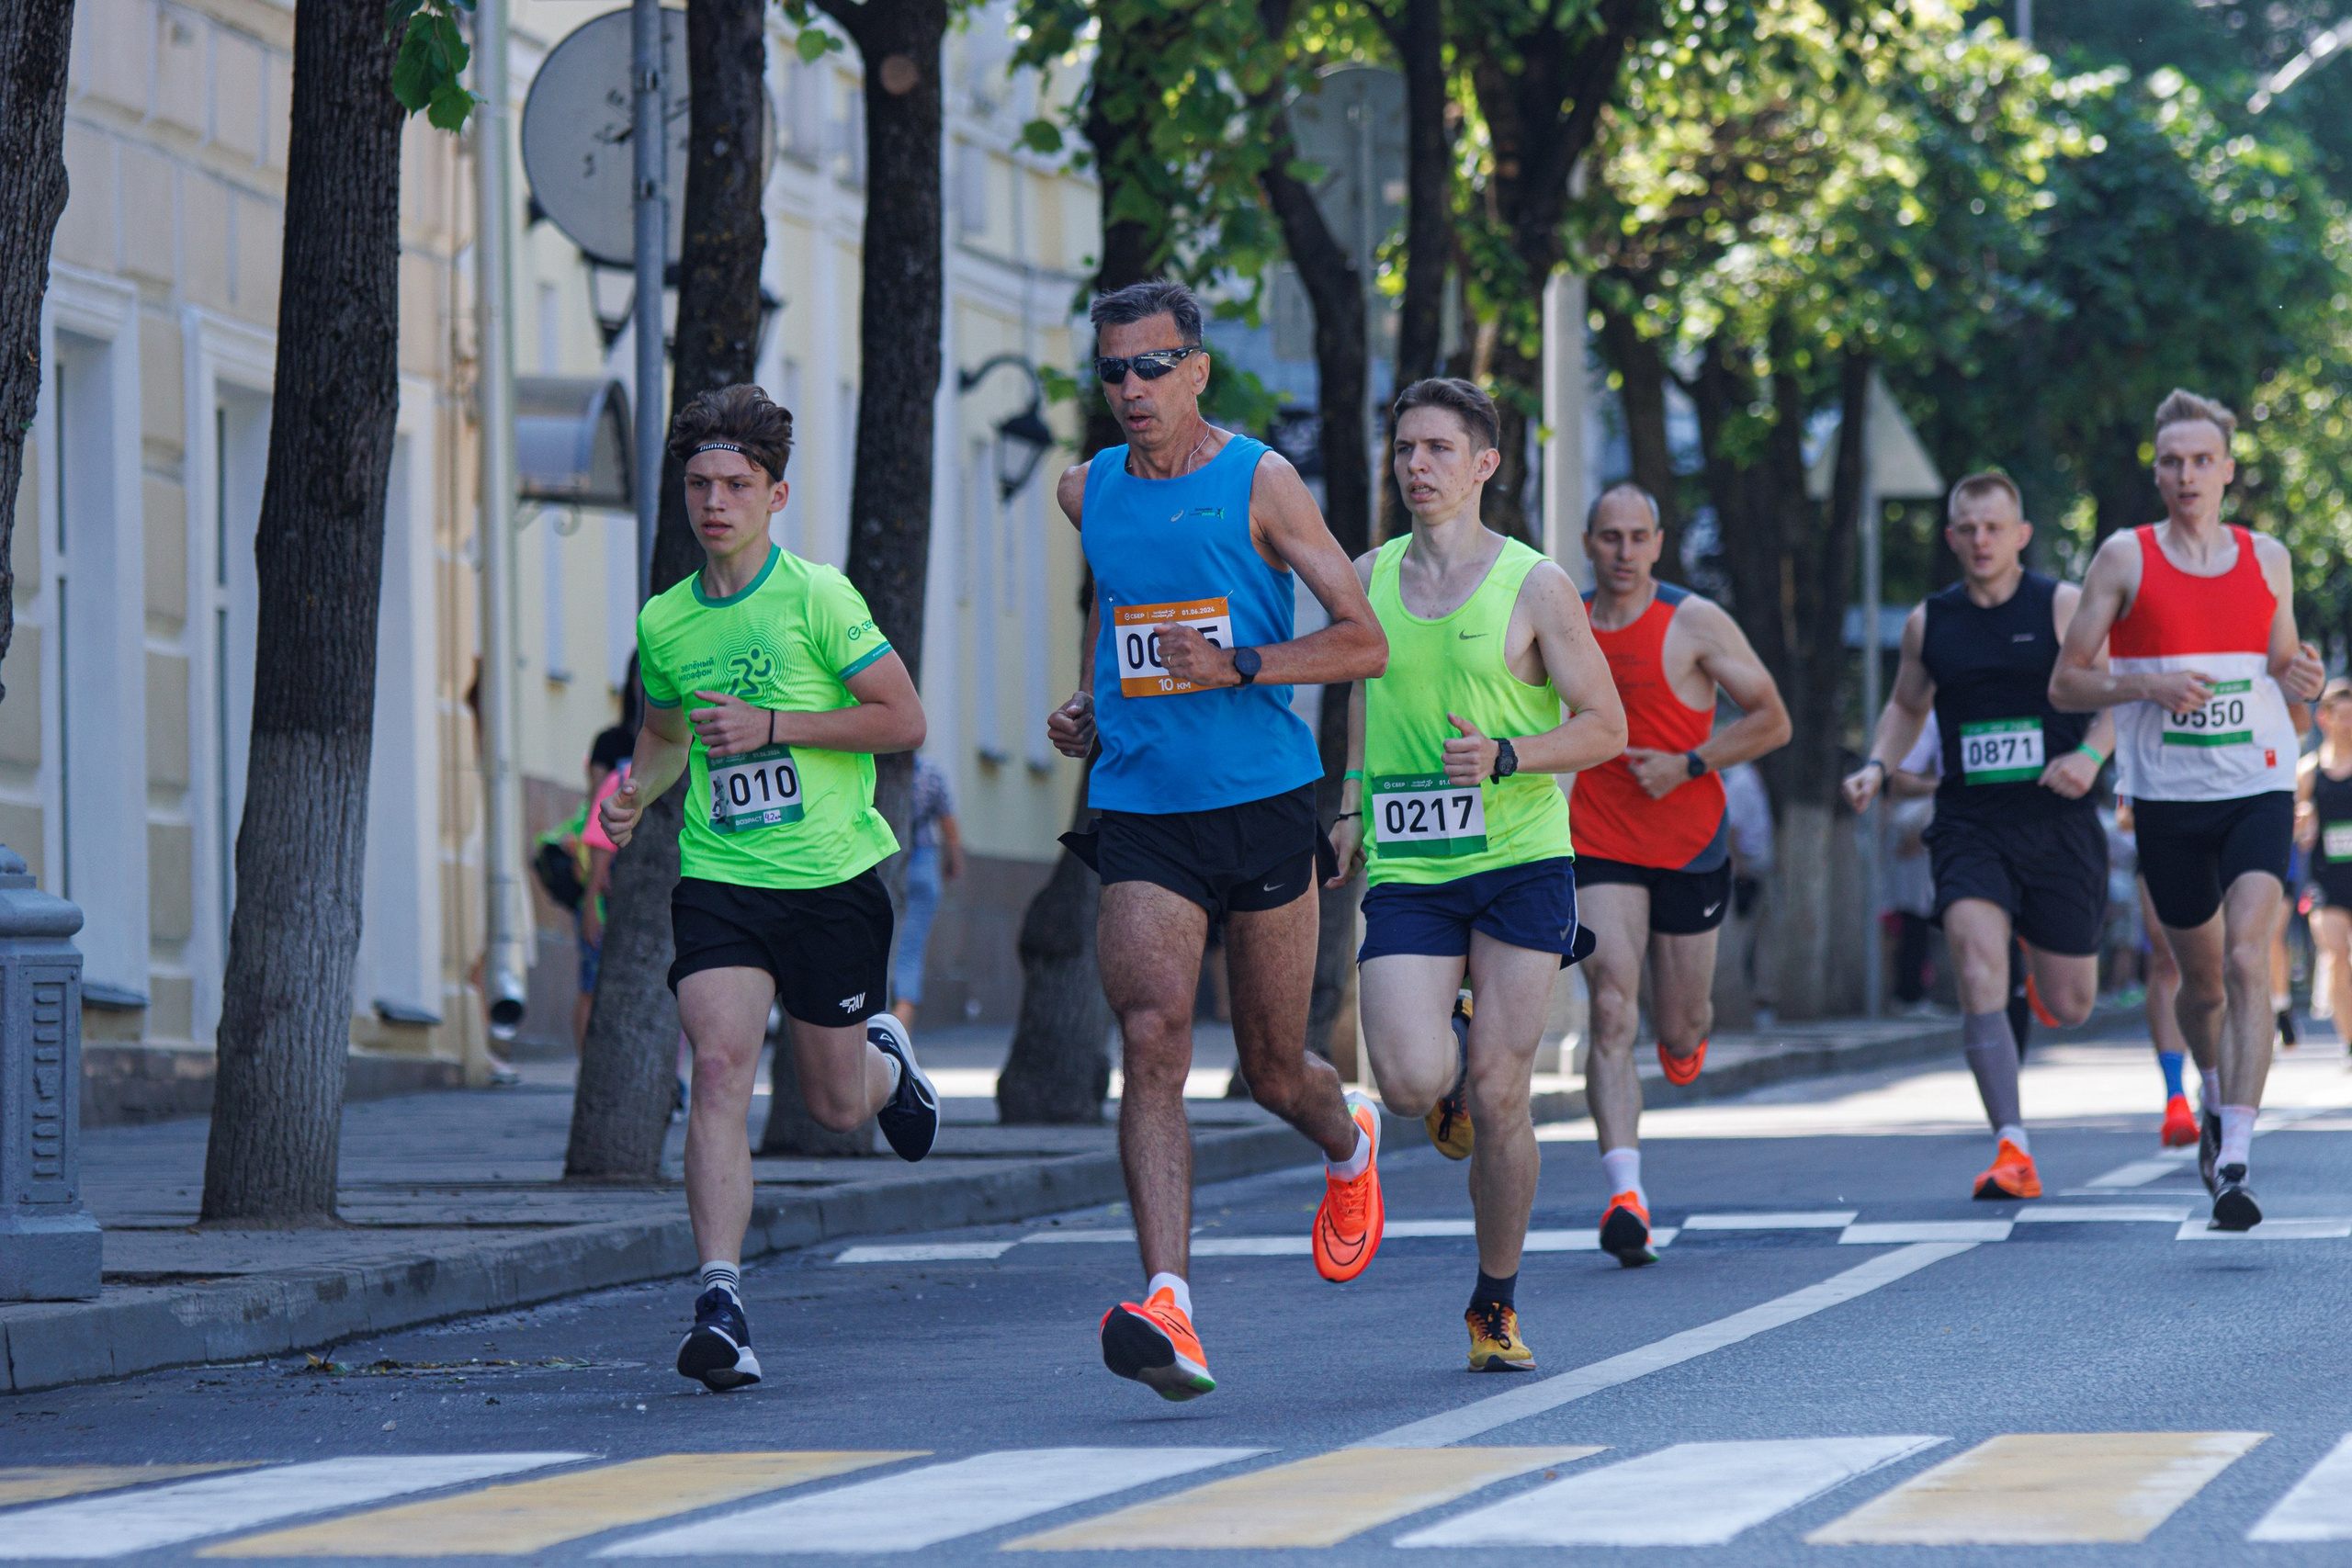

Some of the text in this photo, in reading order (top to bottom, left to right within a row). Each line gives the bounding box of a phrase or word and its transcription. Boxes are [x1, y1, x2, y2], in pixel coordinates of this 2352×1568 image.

[1182, 606, 1215, 615] 01.06.2024
[680, 657, 714, 672] зелёный
[678, 669, 712, 682] марафон
[1159, 678, 1173, 691] 10
[1969, 738, 2031, 766] 0871
[729, 765, 797, 807] 010
[735, 816, 763, 826] ВОЗРАСТ
[1385, 795, 1473, 834] 0217
[840, 992, 865, 1014] RAY
